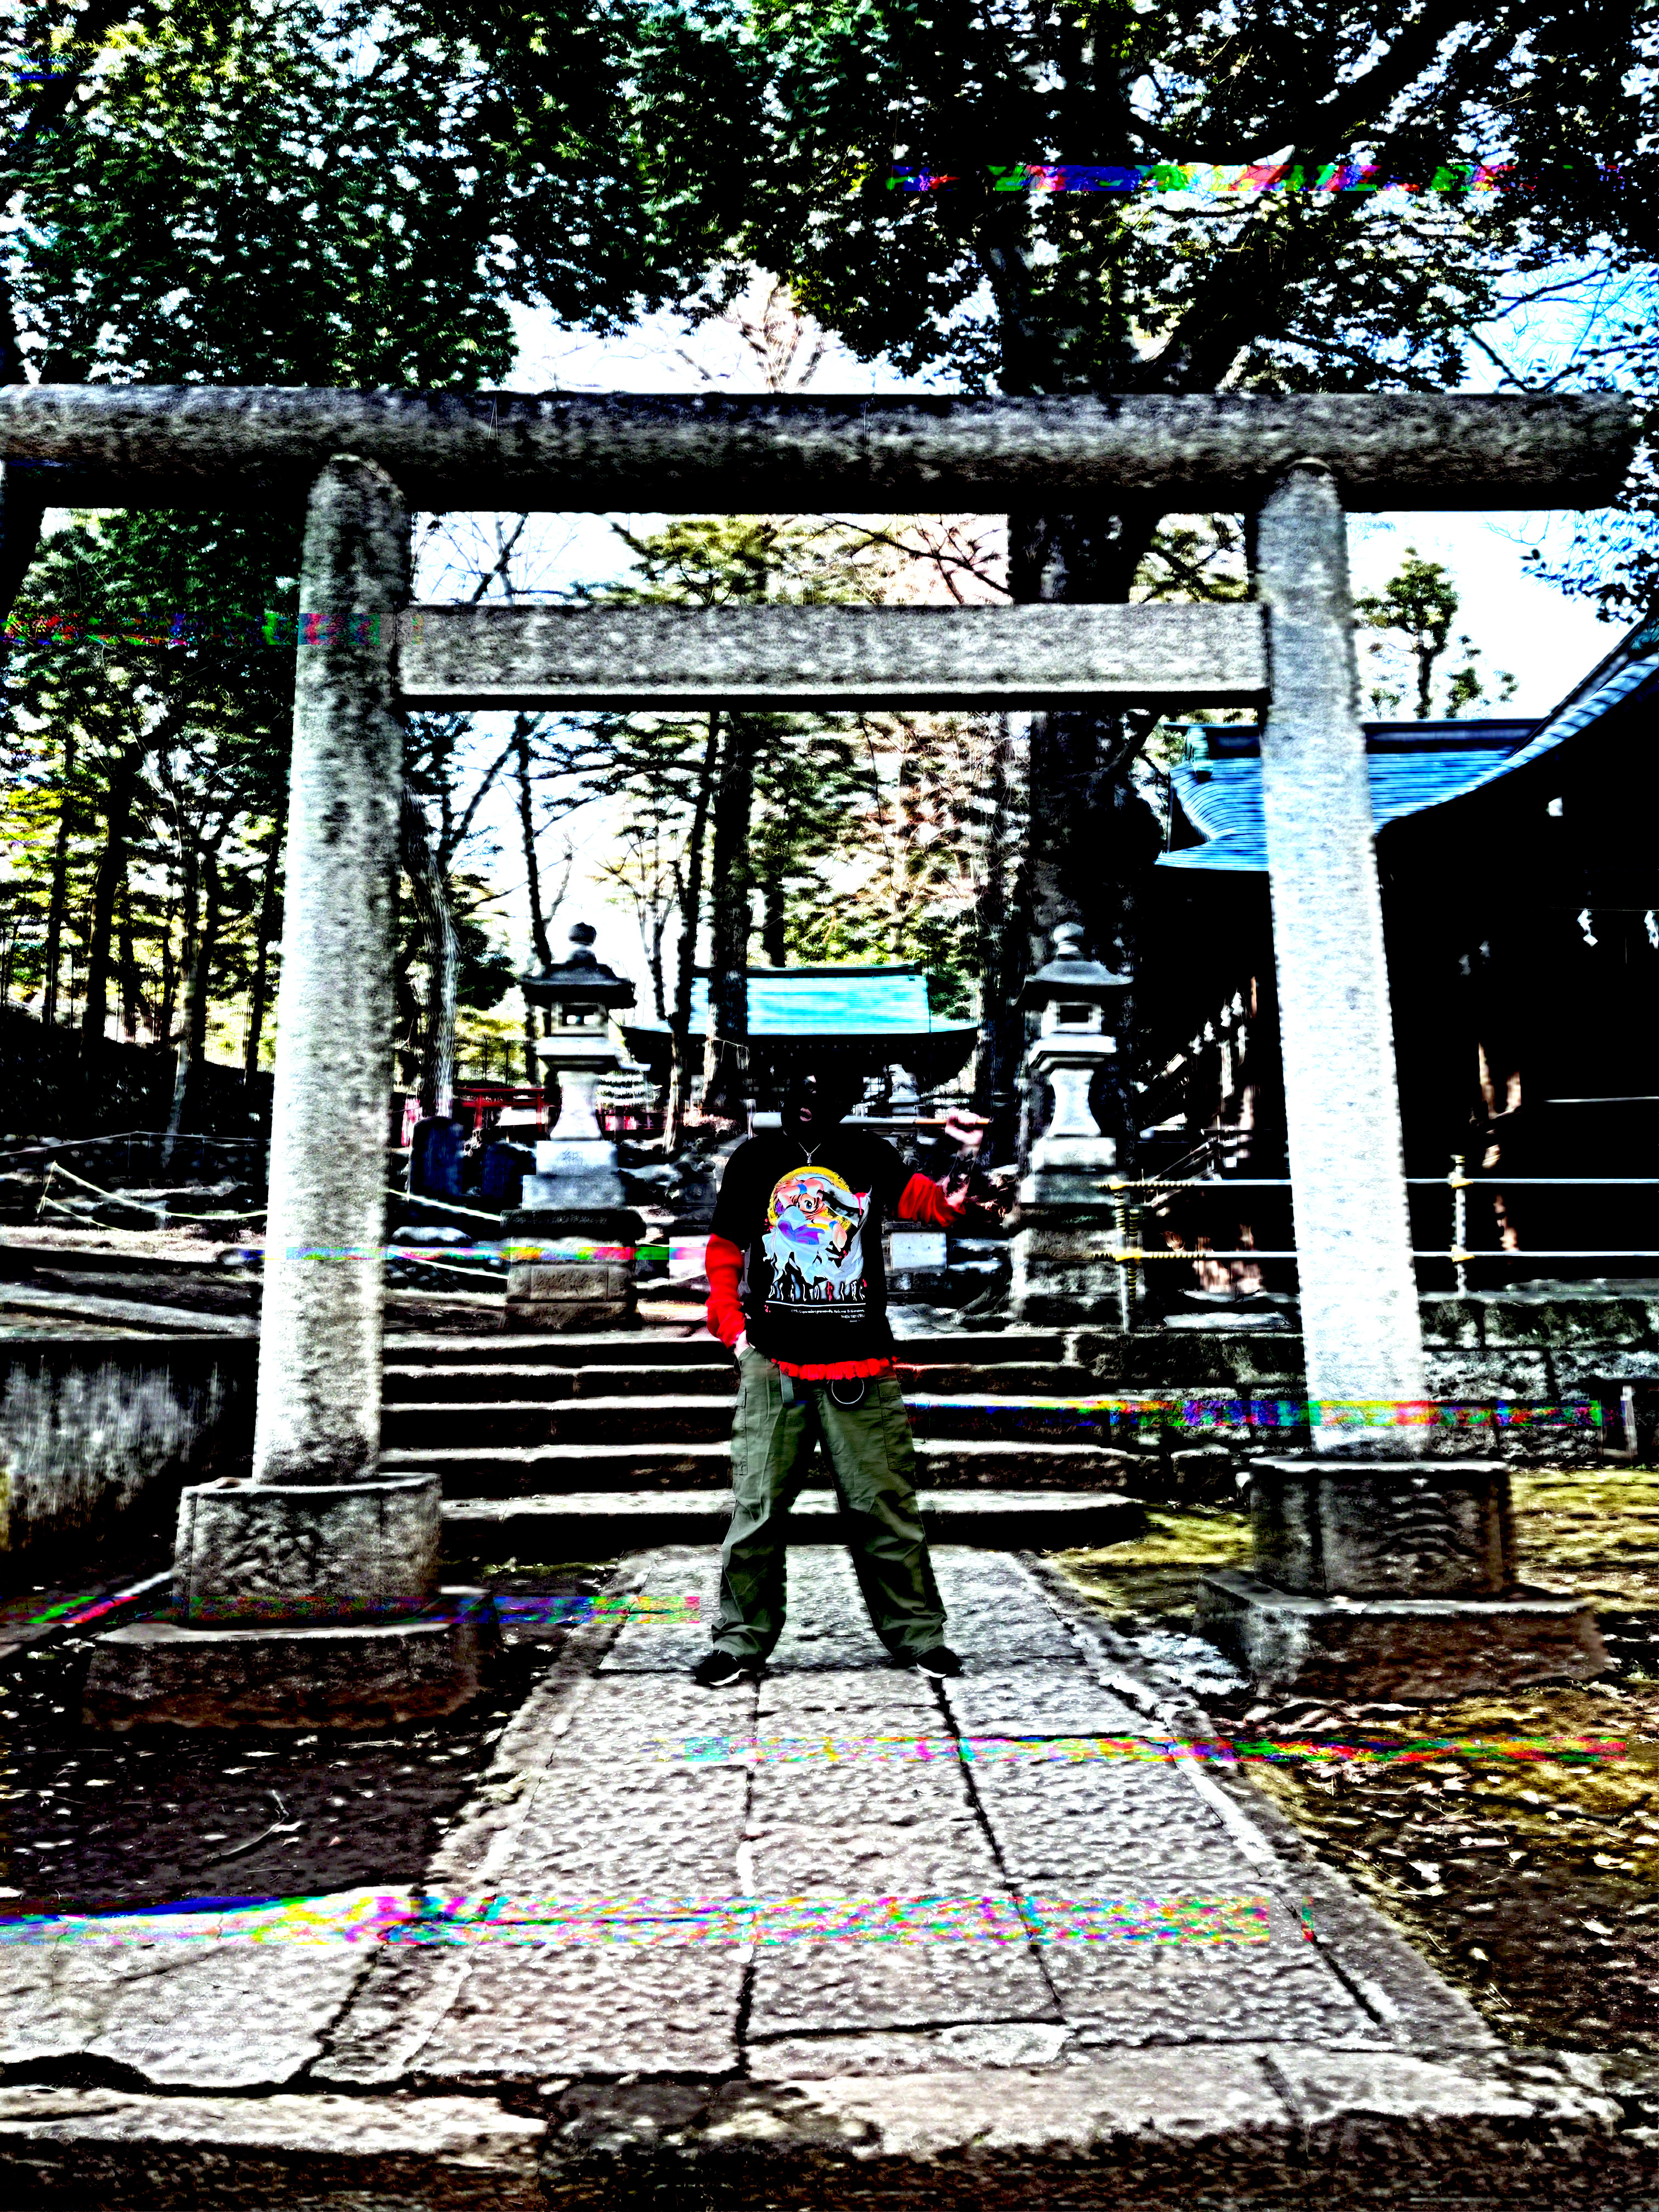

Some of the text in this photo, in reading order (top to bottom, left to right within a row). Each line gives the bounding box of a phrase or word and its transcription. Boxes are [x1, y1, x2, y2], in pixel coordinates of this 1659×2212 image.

[562, 1147, 583, 1166] 納
[768, 1280, 866, 1302] ひぐらしのなく頃に
